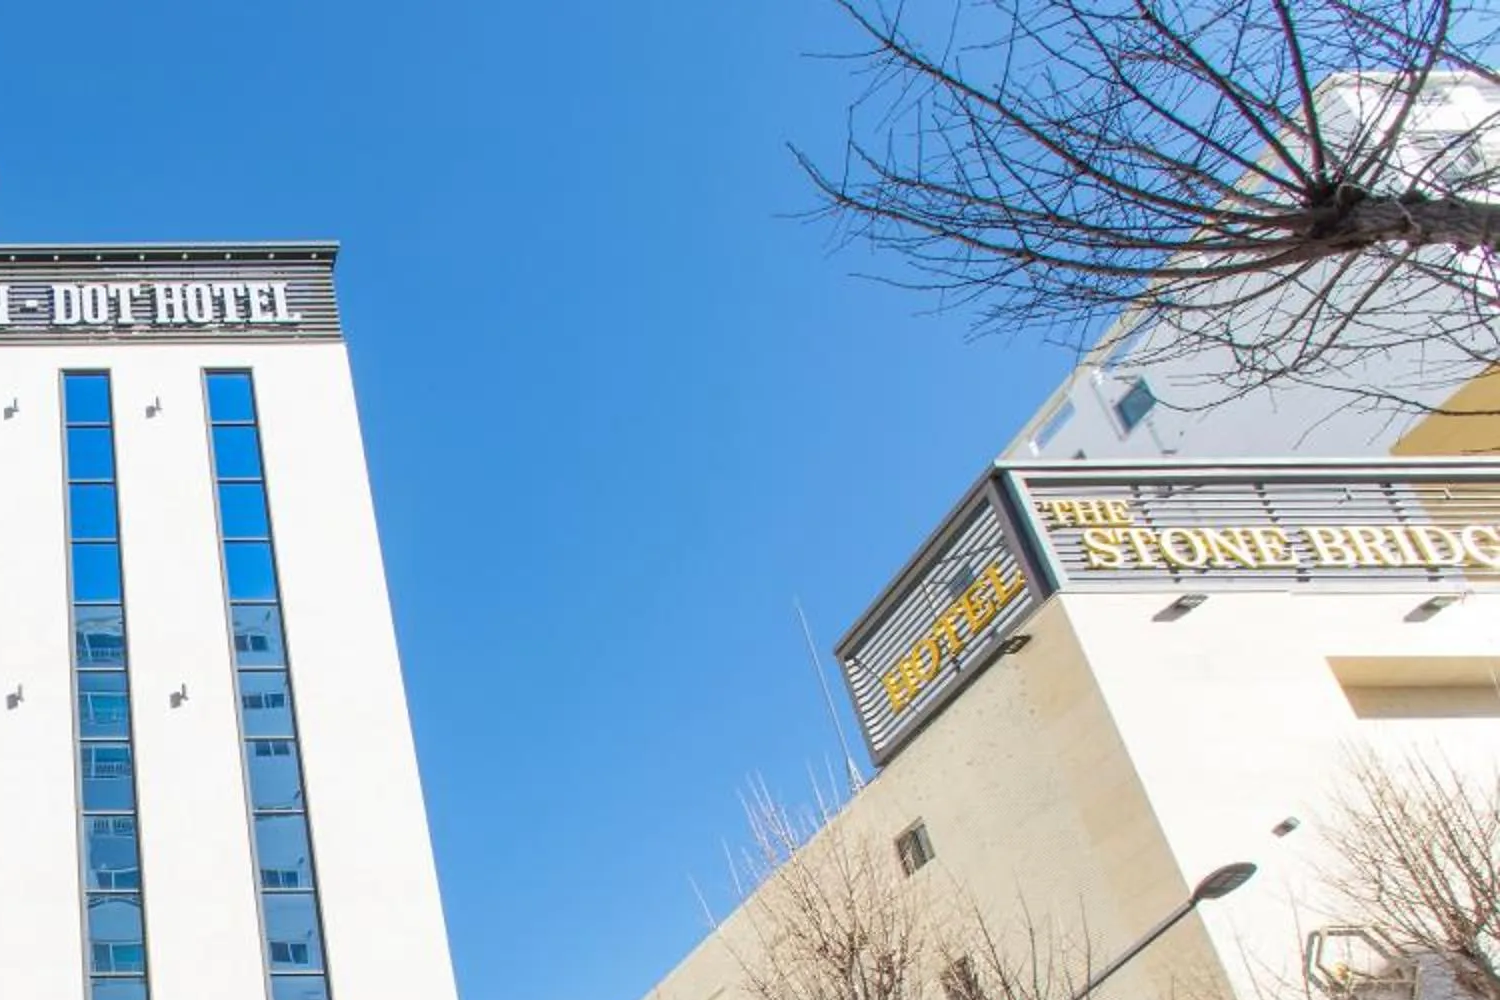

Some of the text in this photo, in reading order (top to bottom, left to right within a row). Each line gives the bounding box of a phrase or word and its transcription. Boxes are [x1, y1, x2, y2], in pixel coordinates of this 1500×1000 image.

[51, 283, 152, 325] DOT
[155, 281, 301, 323] HOTEL
[1046, 499, 1134, 527] THE
[1081, 525, 1500, 570] STONE BRIDG
[881, 563, 1027, 715] HOTEL
